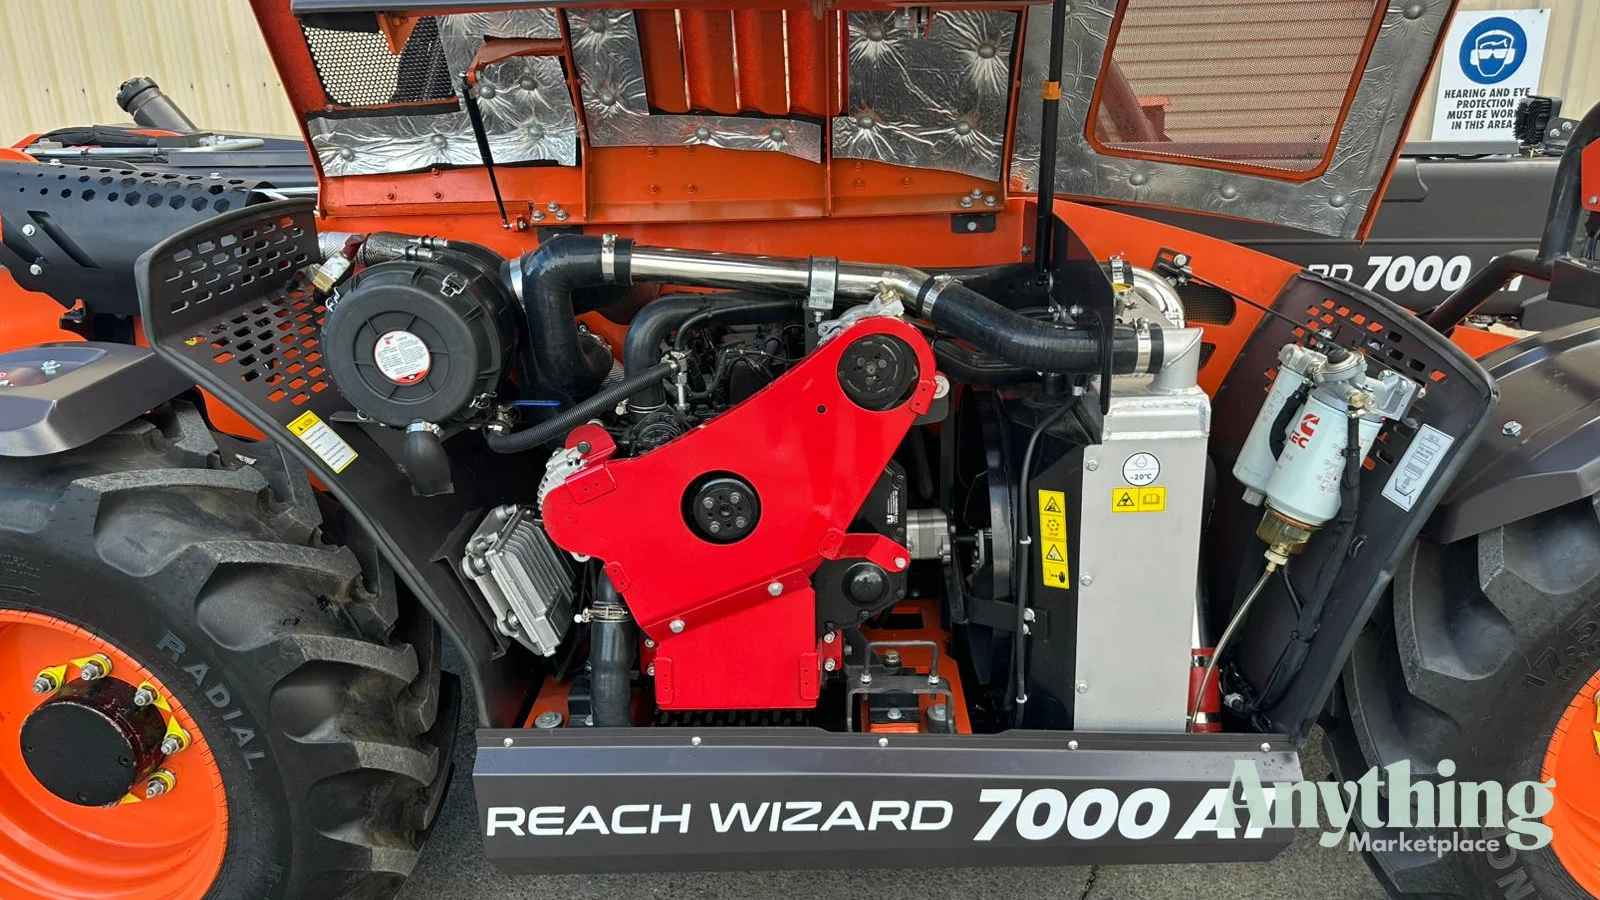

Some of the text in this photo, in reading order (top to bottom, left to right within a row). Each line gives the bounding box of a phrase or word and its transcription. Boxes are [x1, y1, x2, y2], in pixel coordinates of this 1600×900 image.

[1444, 87, 1531, 99] HEARING AND EYE
[1456, 99, 1514, 109] PROTECTION
[1446, 110, 1473, 120] MUST
[1475, 110, 1488, 119] BE
[1451, 120, 1513, 130] IN THIS AREA
[1362, 255, 1472, 292] 7000
[157, 630, 265, 770] RADIAL
[486, 803, 691, 836] REACH
[709, 800, 954, 833] WIZARD
[973, 787, 1171, 841] 7000
